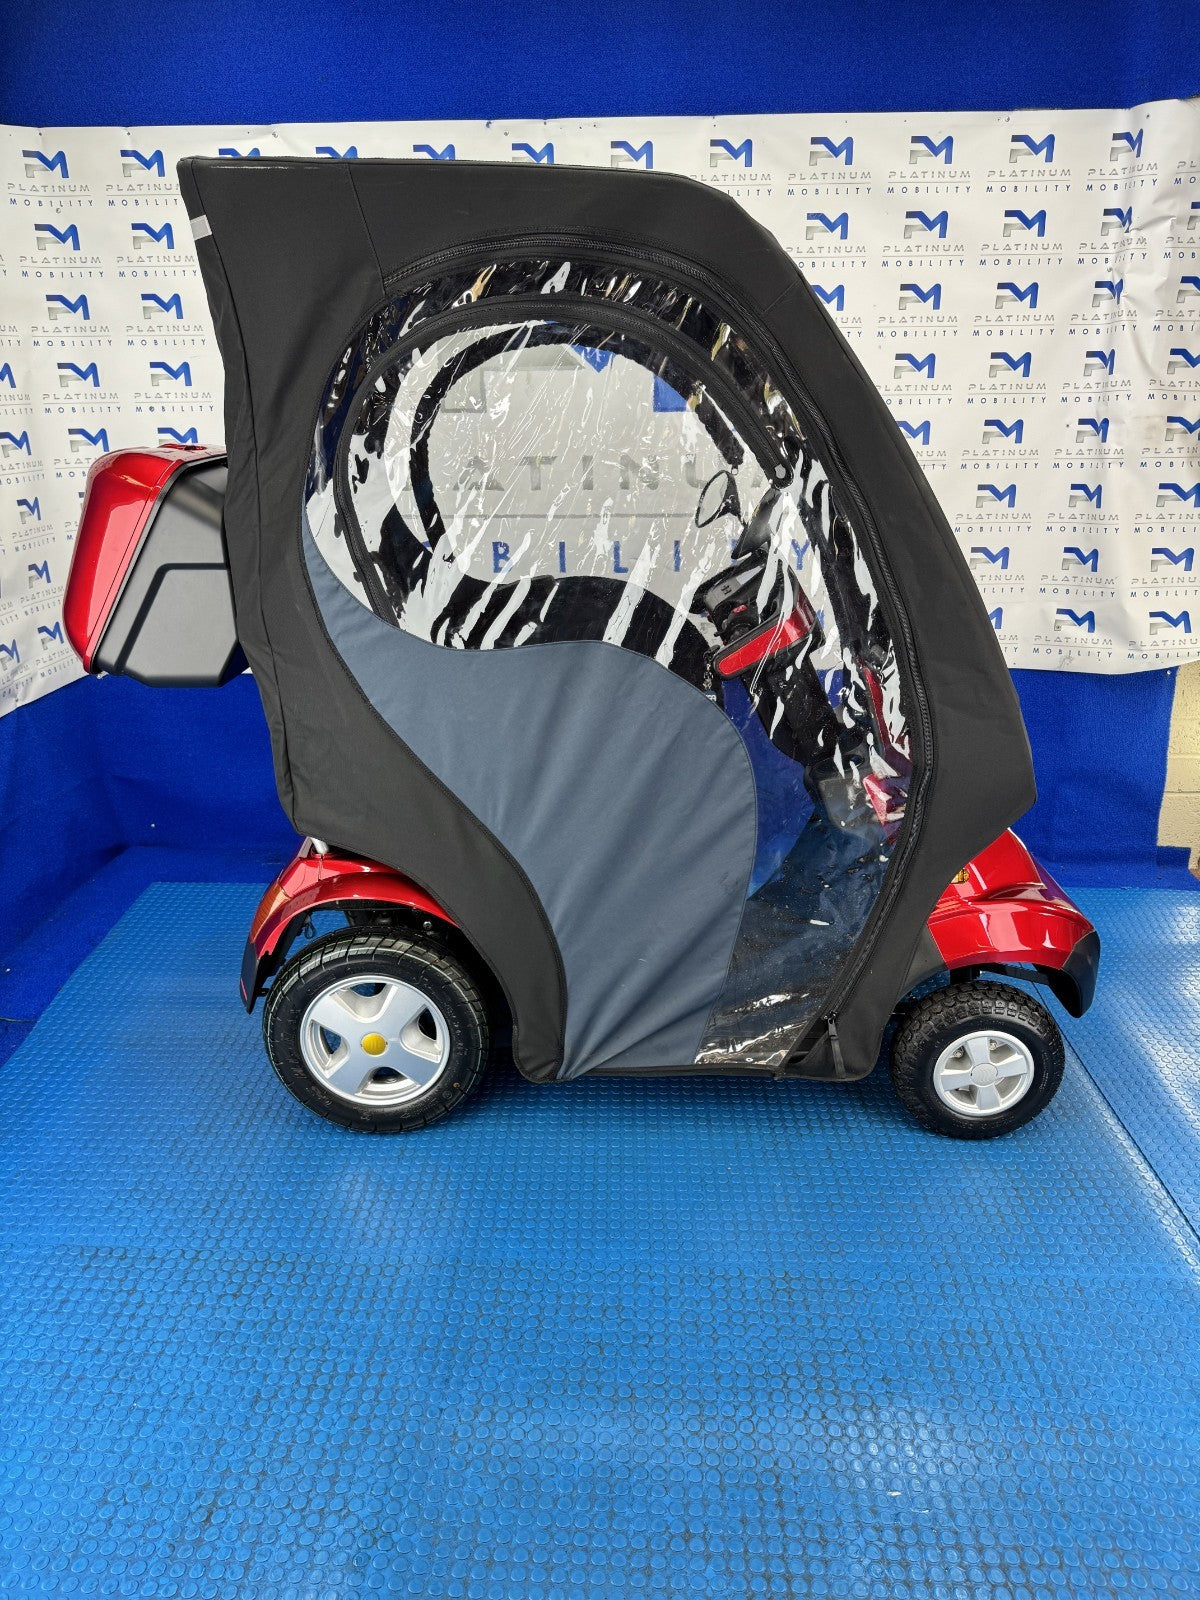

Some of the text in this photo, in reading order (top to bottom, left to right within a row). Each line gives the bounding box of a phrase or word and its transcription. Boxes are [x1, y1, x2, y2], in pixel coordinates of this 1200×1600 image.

[788, 171, 872, 180] PLATINUM
[888, 169, 971, 179] PLATINUM
[987, 168, 1071, 178] PLATINUM
[8, 183, 90, 192] PLATINUM
[106, 183, 179, 192] PLATINU
[787, 186, 872, 195] MOBILITY
[887, 185, 971, 194] MOBILITY
[986, 184, 1071, 193] MOBILITY
[9, 198, 93, 207] MOBILITY
[108, 199, 178, 207] MOBILIT
[883, 244, 965, 253] PLATINUM
[981, 242, 1063, 251] PLATINUM
[20, 256, 101, 264] PLATINUM
[117, 255, 195, 263] PLATINUM
[882, 258, 964, 268] MOBILITY
[979, 257, 1063, 266] MOBILITY
[798, 260, 867, 268] OBILITY
[21, 270, 104, 278] MOBILITY
[119, 269, 197, 278] MOBILITY
[878, 315, 958, 324] PLATINUM
[973, 313, 1055, 322] PLATINUM
[31, 325, 110, 333] PLATINUM
[126, 324, 203, 332] PLATINUM
[972, 328, 1055, 337] MOBILITY
[876, 329, 958, 338] MOBILITY
[33, 339, 112, 347] MOBILITY
[127, 338, 206, 346] MOBILITY
[968, 382, 1046, 391] PLATINUM
[42, 392, 119, 400] PLATINUM
[967, 396, 1046, 404] MOBILITY
[1148, 393, 1197, 401] MOBIL
[886, 397, 953, 405] OBILITY
[45, 406, 121, 414] MOBILITY
[961, 448, 1039, 457] PLATINUM
[1, 460, 43, 471] LATINUM
[960, 462, 1039, 470] MOBILITY
[0, 473, 45, 486] OBILITY
[955, 512, 1031, 520] PLATINUM
[1047, 512, 1119, 521] PLATINUM
[1046, 526, 1120, 534] MOBILITY
[1133, 526, 1197, 534] MOBILI
[1040, 574, 1115, 585] PLATINUM
[1131, 576, 1197, 585] PLATINU
[1039, 587, 1115, 597] MOBILITY
[1130, 589, 1199, 598] MOBILIT
[1034, 635, 1113, 645] PLATINUM
[1128, 638, 1198, 647] PLATINU
[1032, 647, 1113, 658] MOBILITY
[1127, 651, 1200, 660] MOBILIT
